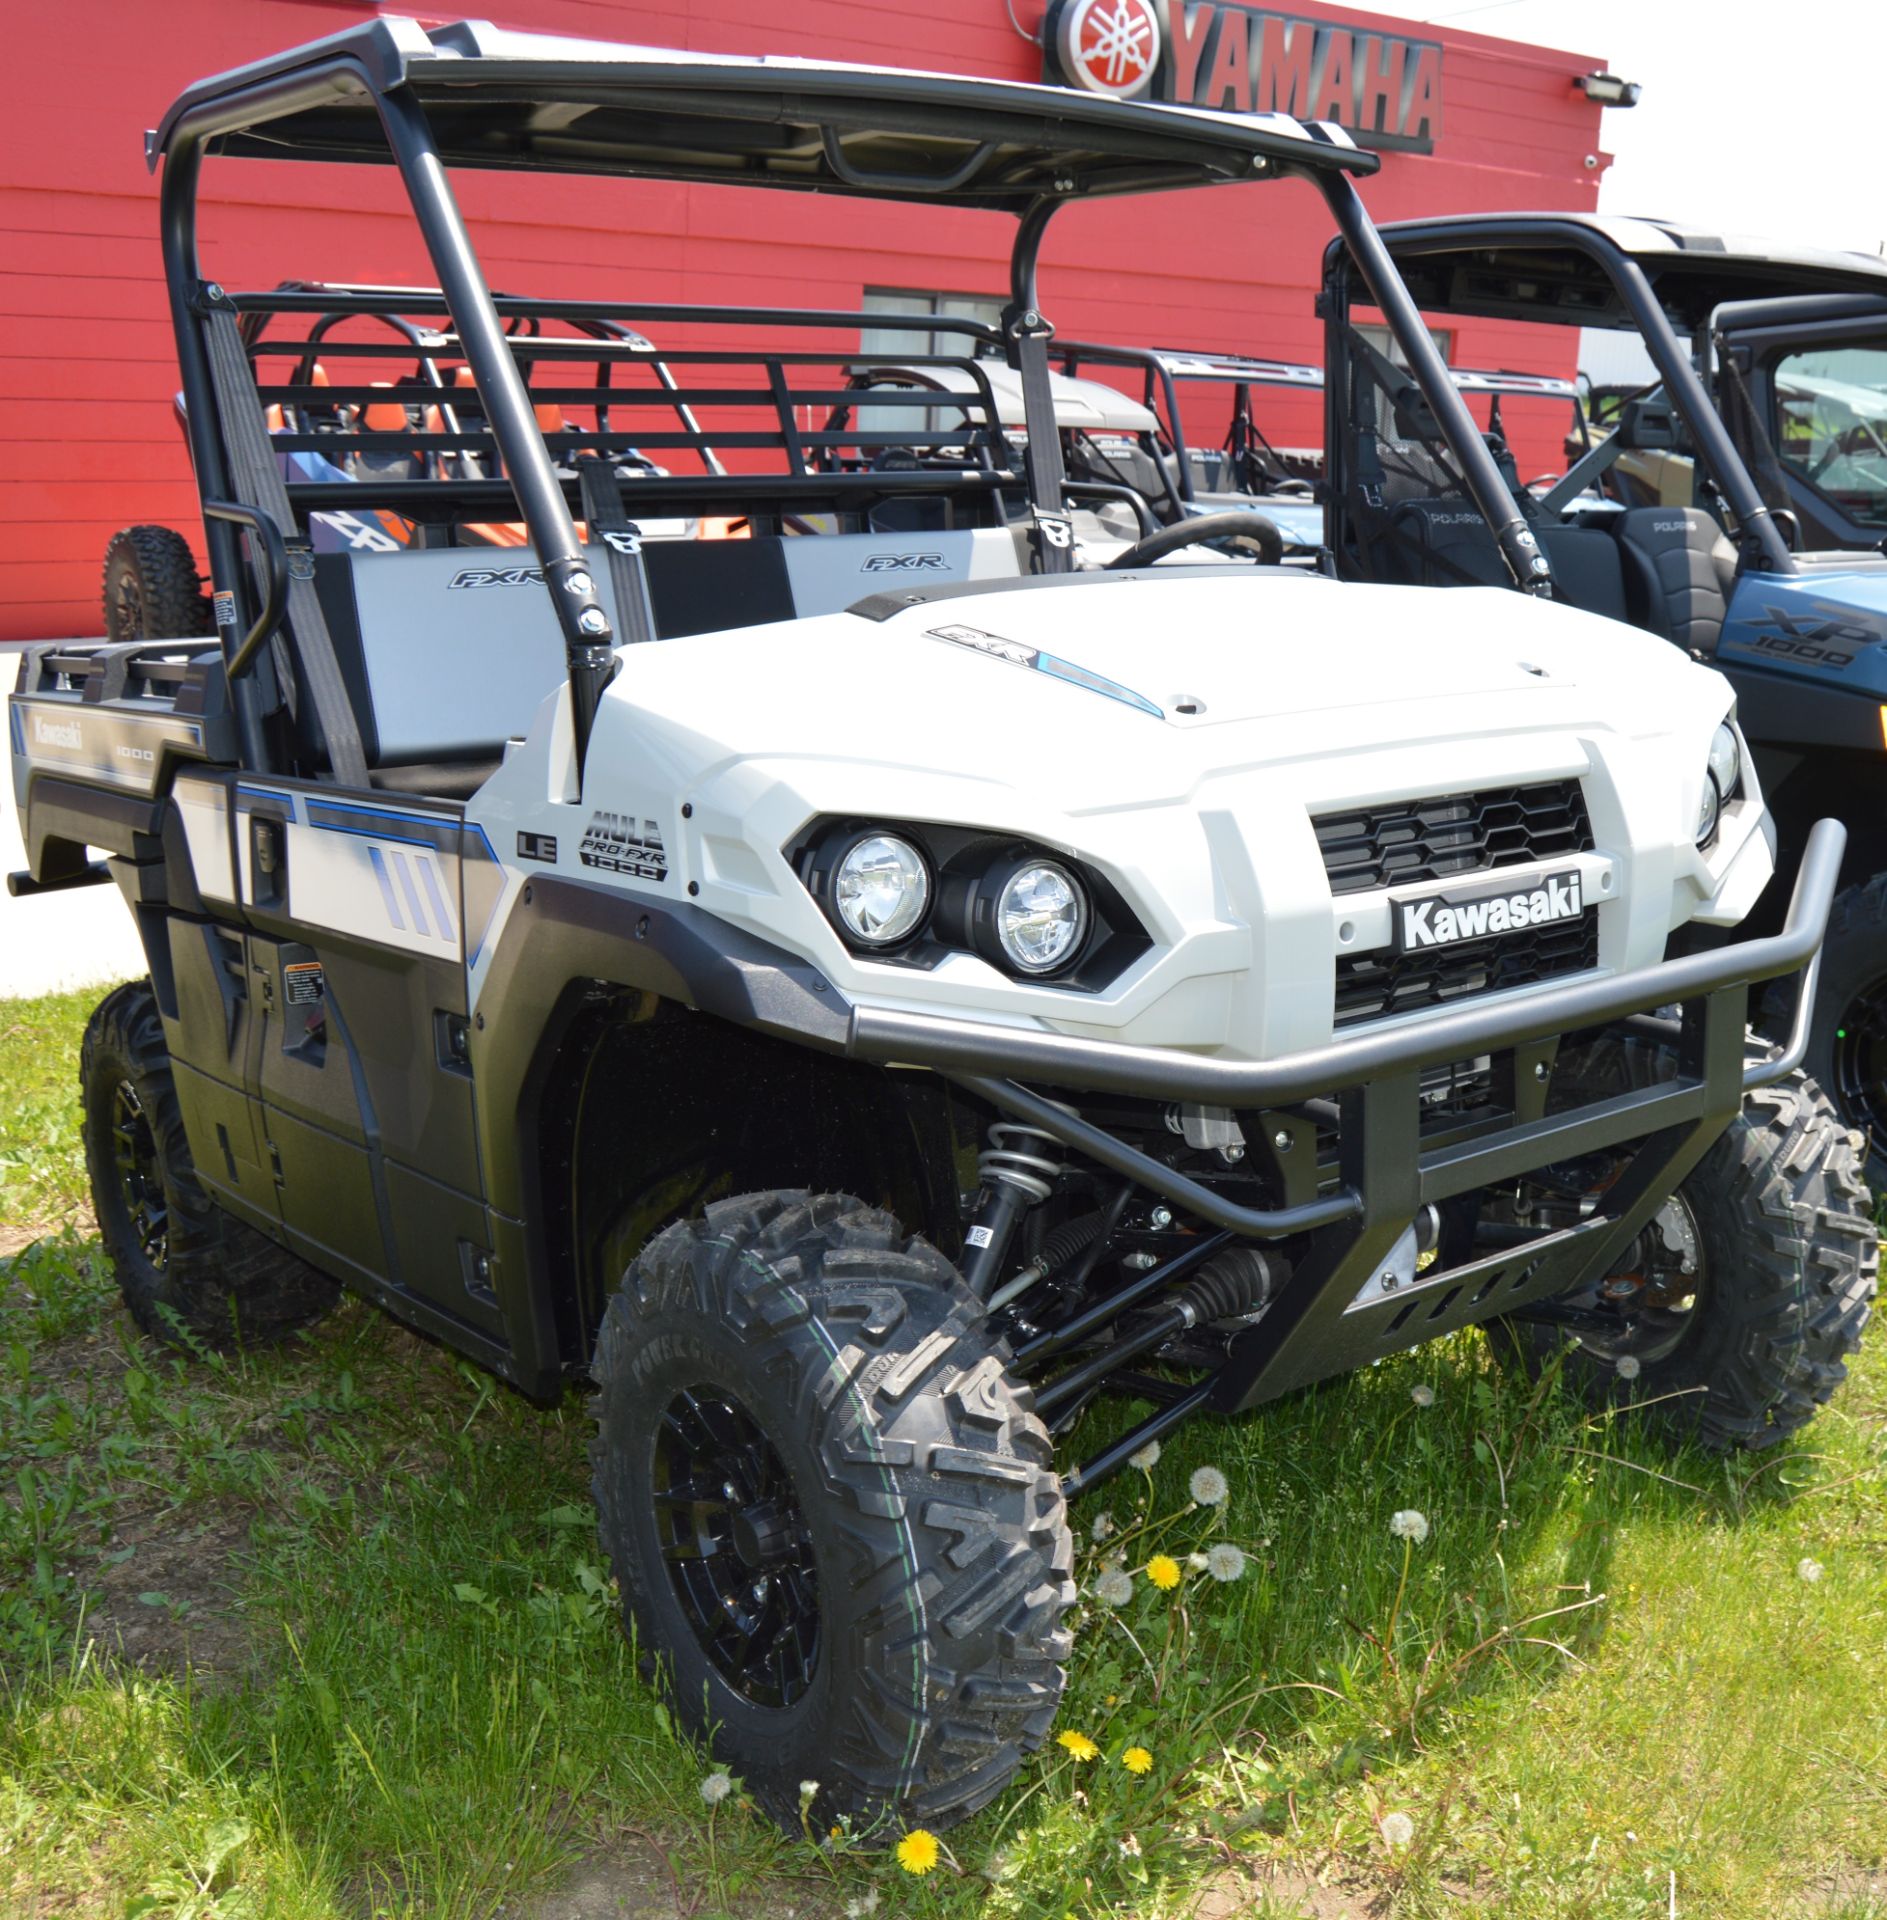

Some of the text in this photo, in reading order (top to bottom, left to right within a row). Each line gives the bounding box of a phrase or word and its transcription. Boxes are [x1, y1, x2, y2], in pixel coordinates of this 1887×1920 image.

[1169, 1, 1442, 139] YAMAHA
[861, 553, 952, 573] FXR
[1742, 604, 1883, 644] XP
[929, 626, 1037, 667] FXR
[1755, 635, 1857, 667] 1000
[34, 715, 82, 750] Kawasaki
[117, 745, 154, 761] 1000
[518, 834, 556, 861] LE
[585, 811, 665, 851] MULE
[580, 839, 667, 867] PRO-FXR
[589, 854, 659, 880] 1000
[1403, 874, 1581, 949] Kawasaki
